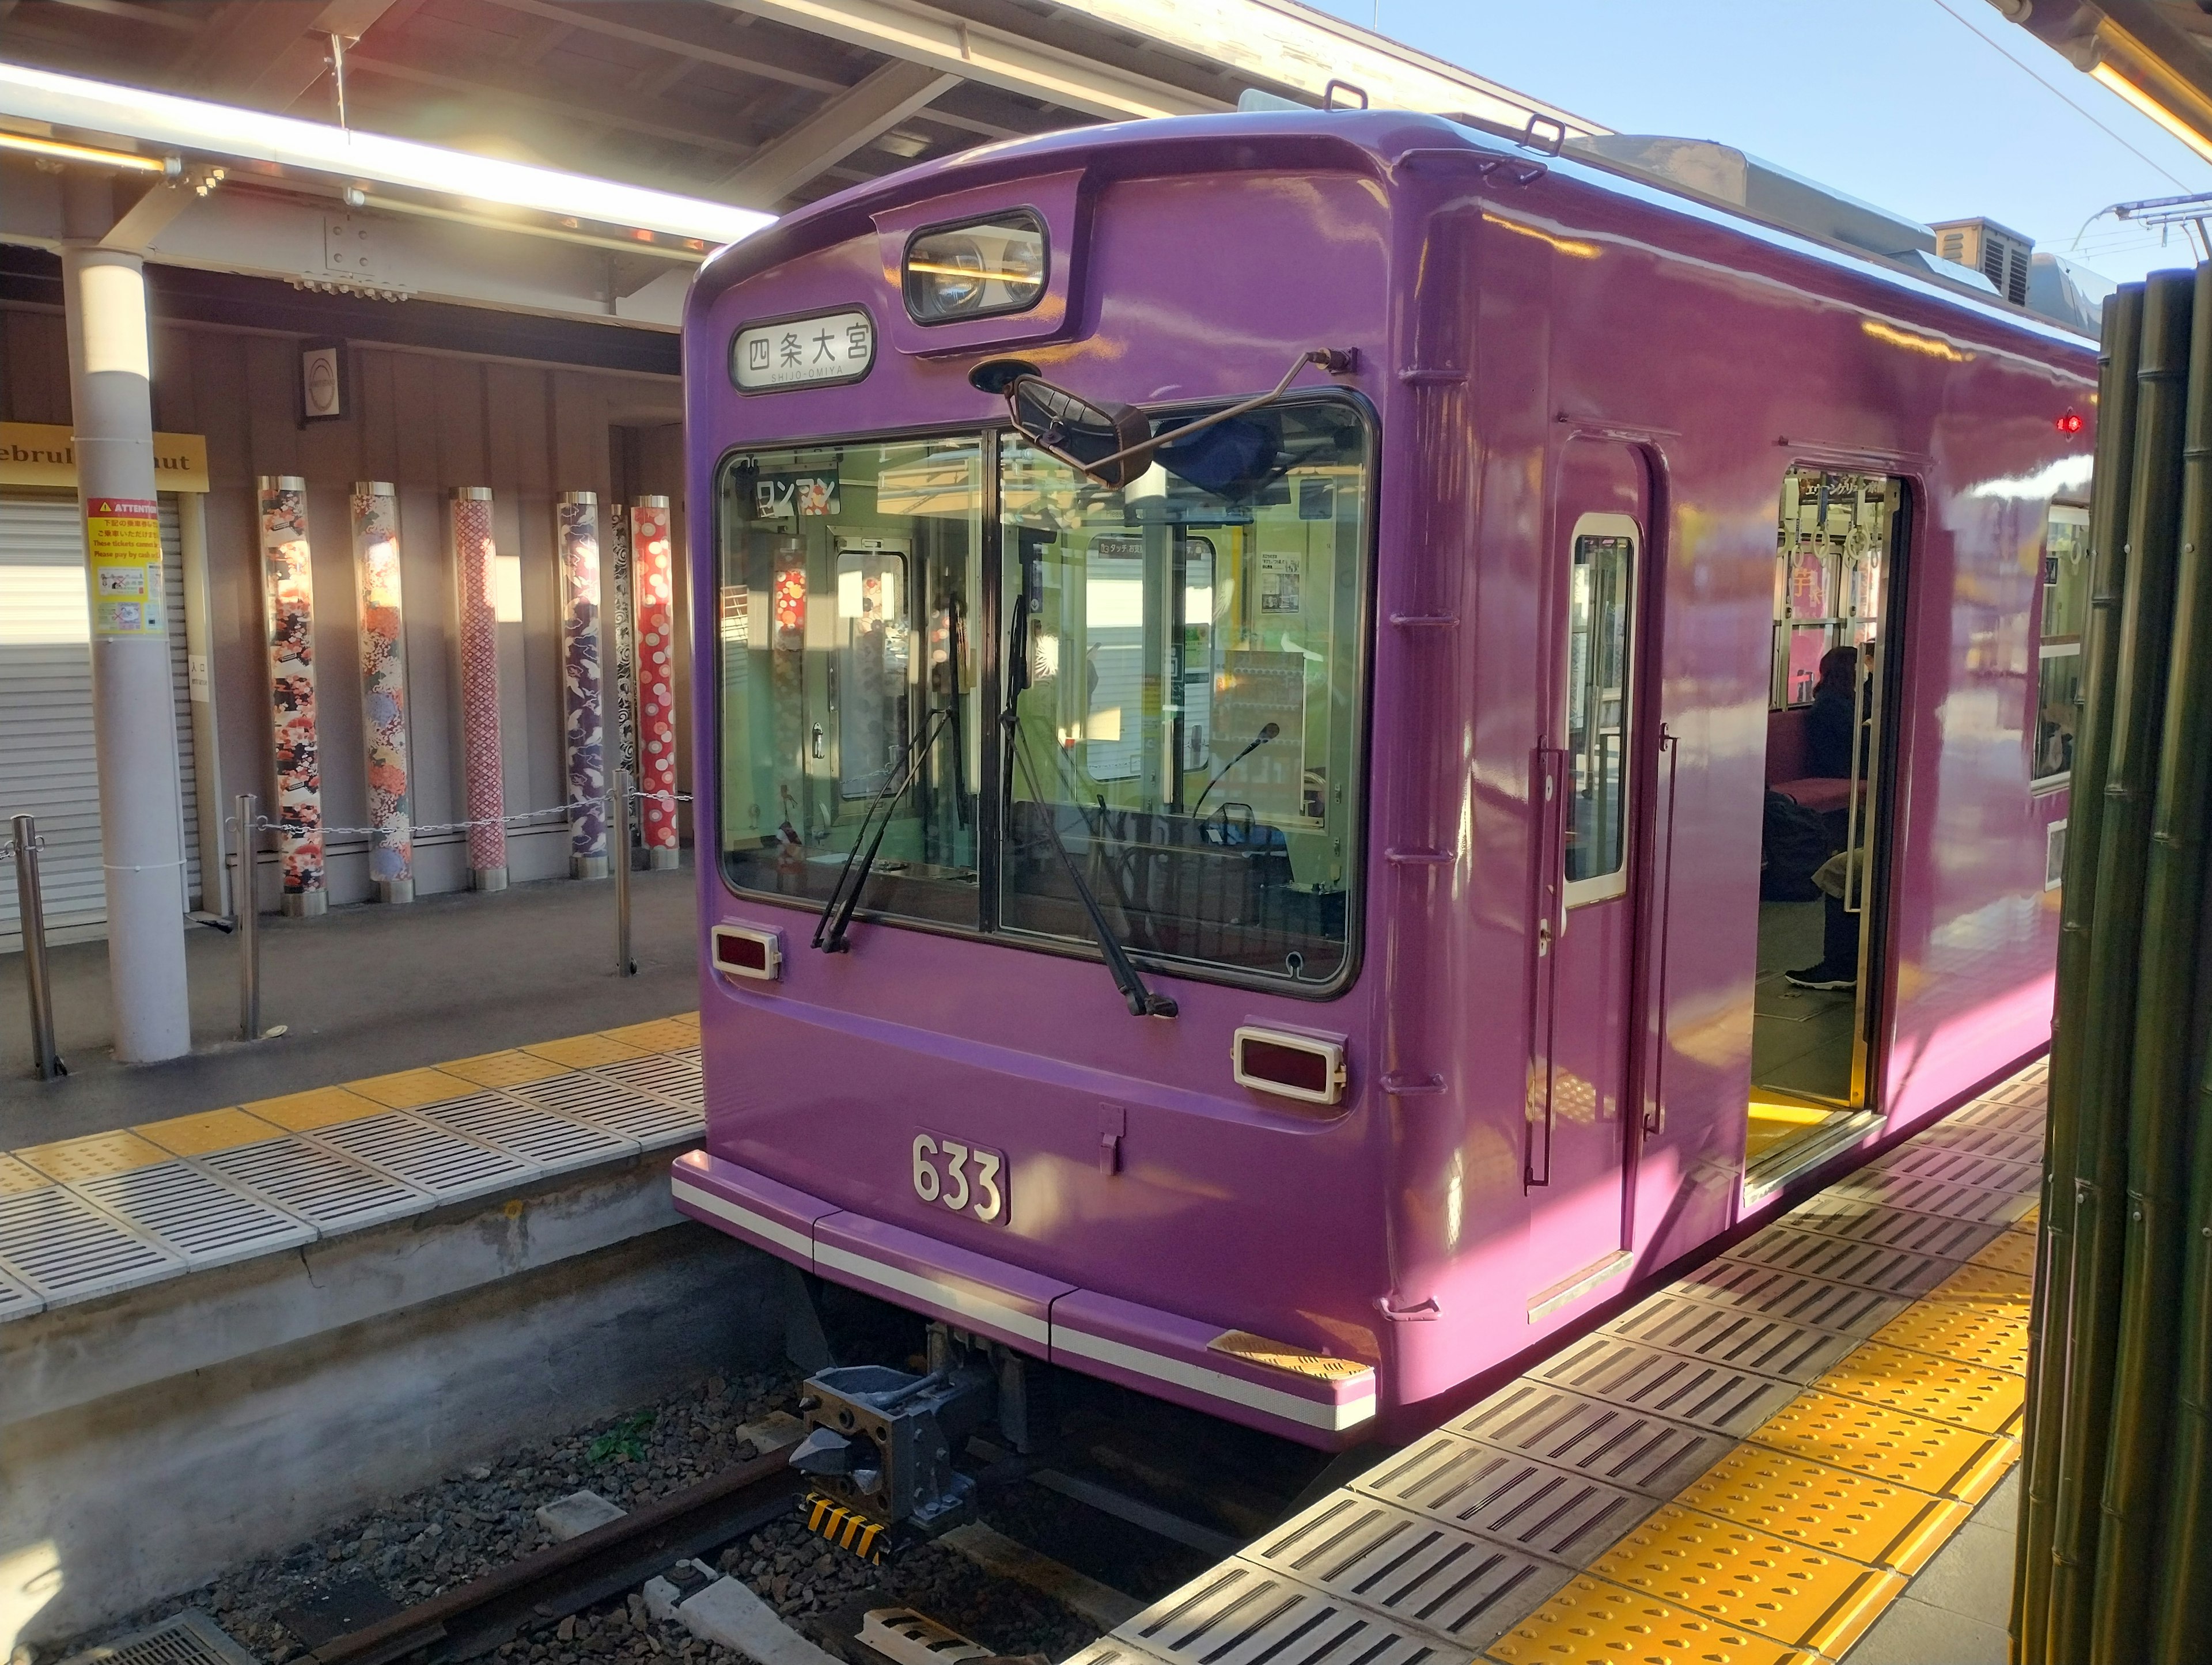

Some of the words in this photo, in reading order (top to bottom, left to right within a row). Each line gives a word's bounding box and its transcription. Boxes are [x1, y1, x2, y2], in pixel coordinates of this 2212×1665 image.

[750, 323, 869, 370] 四条大宮
[771, 365, 843, 382] SHIJO-OMIYA
[757, 478, 835, 509] ワンマン
[192, 662, 204, 672] 入口
[913, 1134, 1001, 1220] 633
